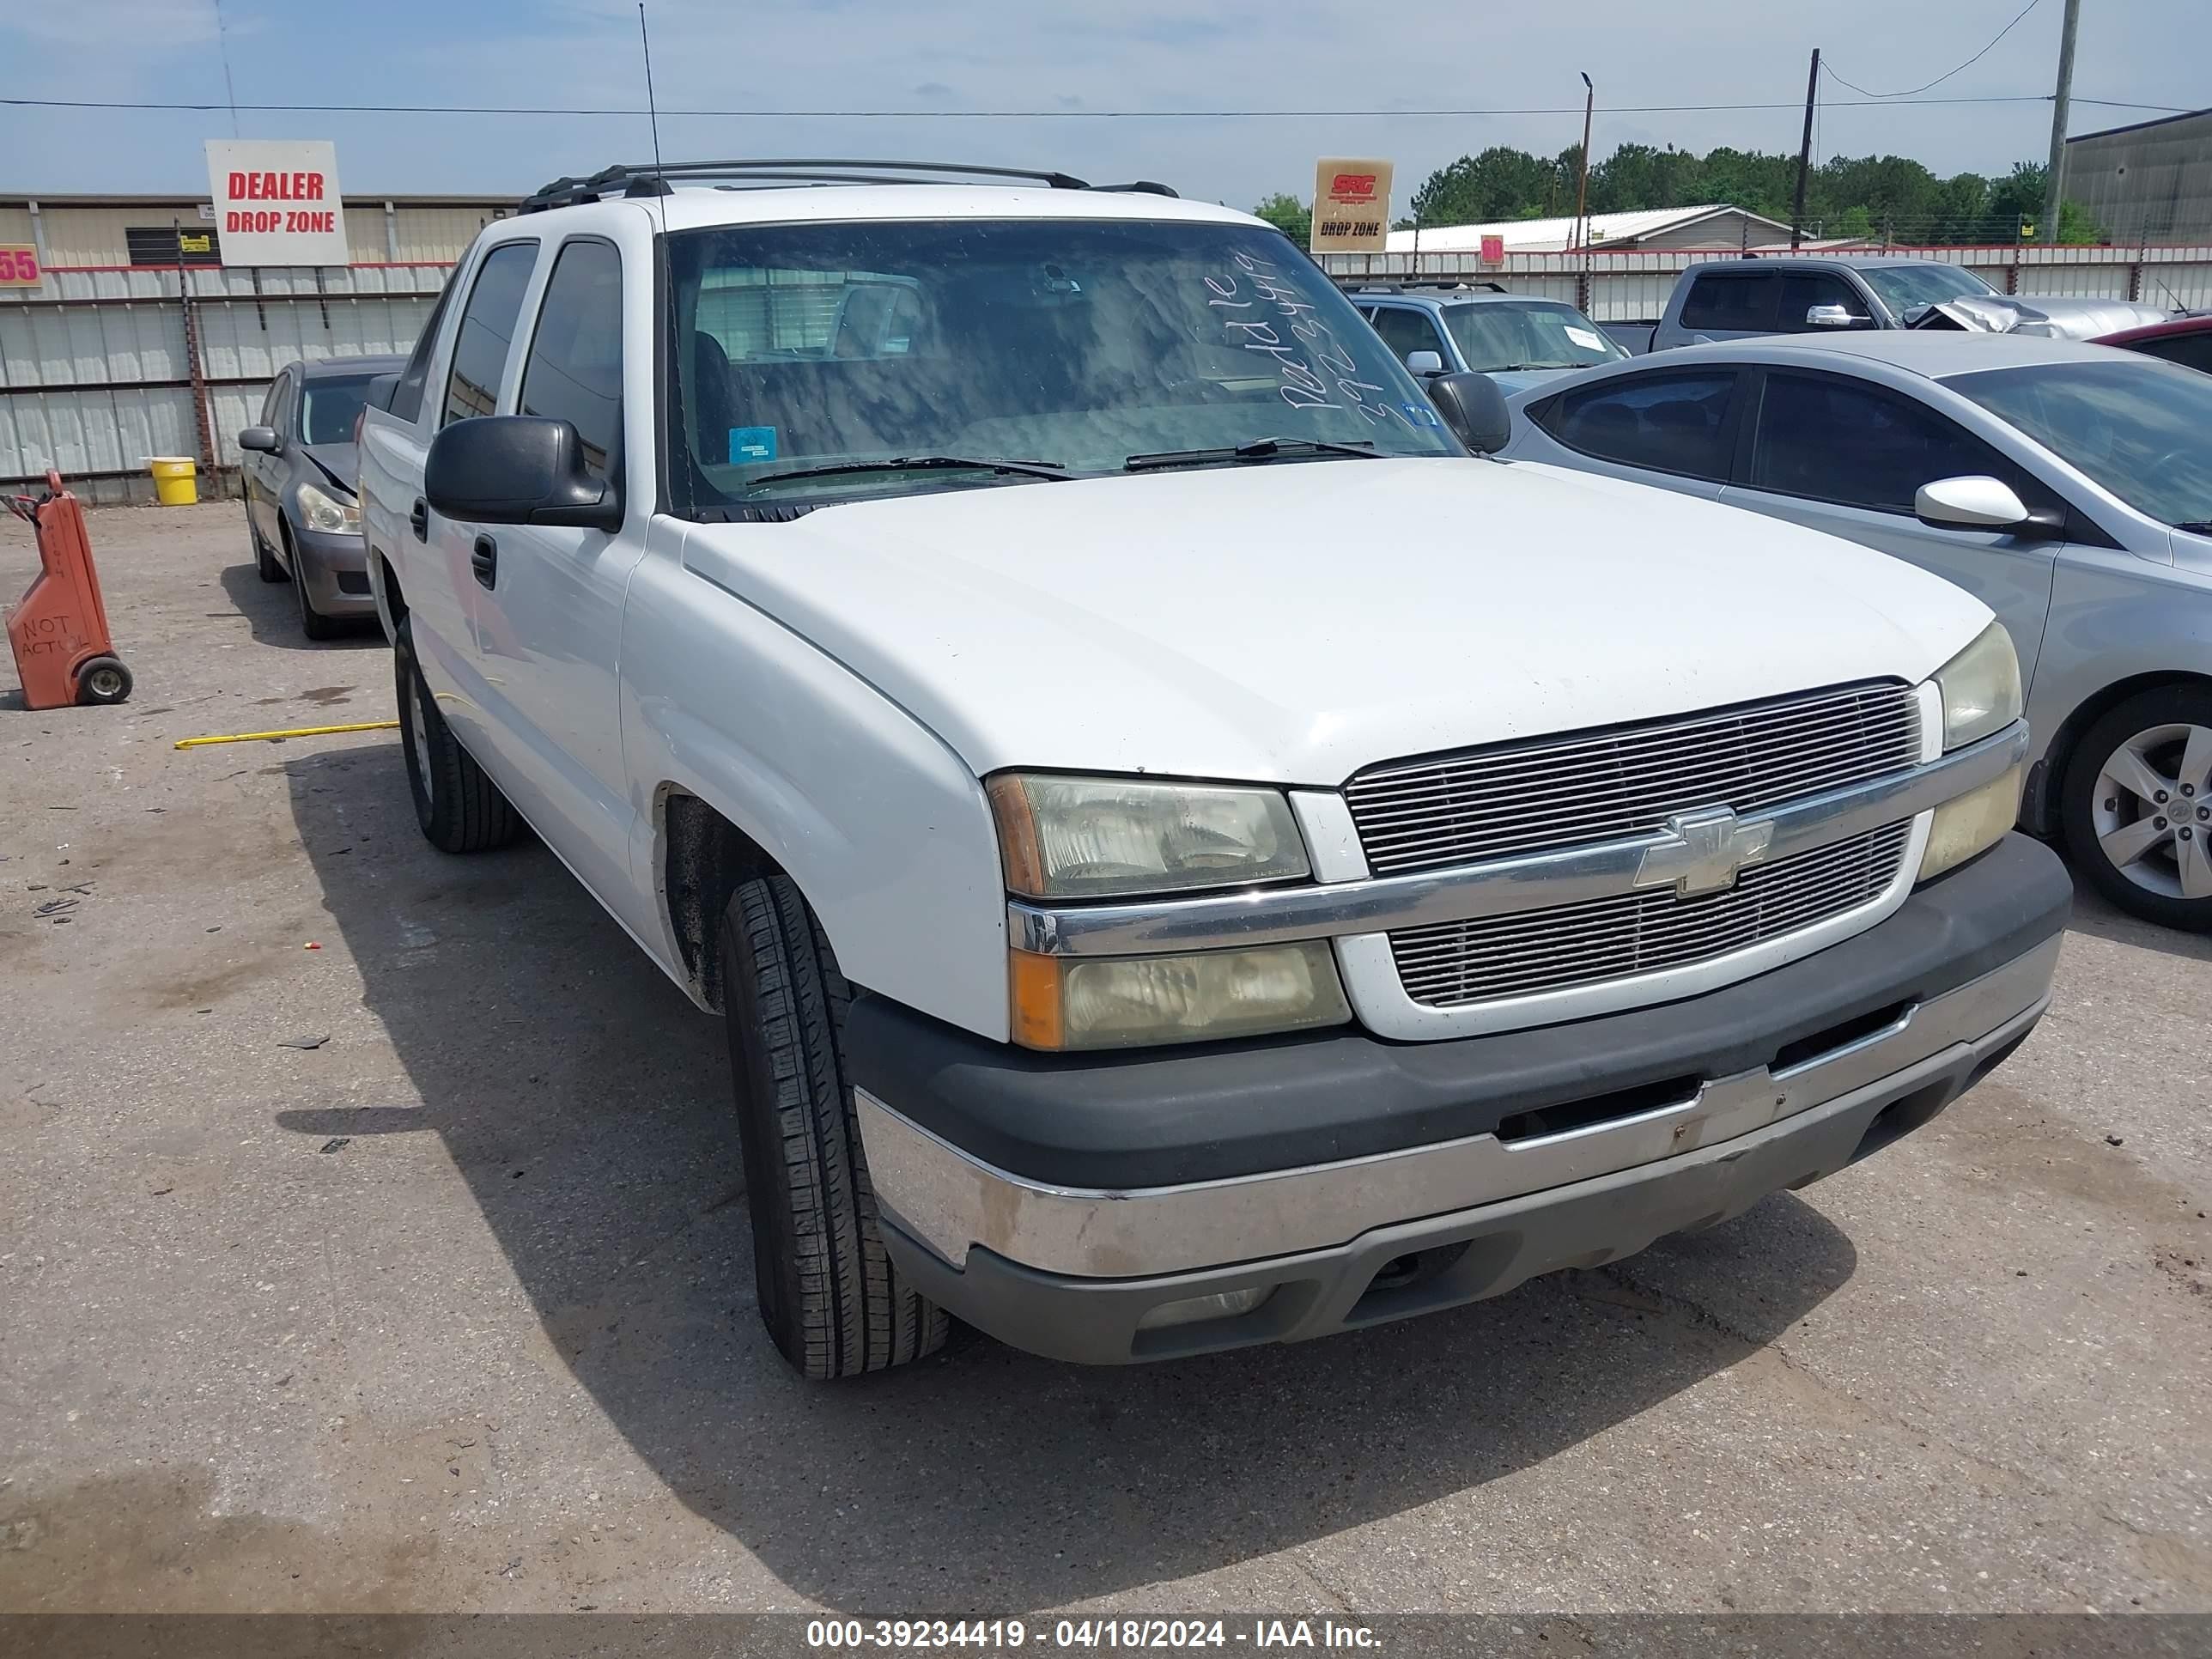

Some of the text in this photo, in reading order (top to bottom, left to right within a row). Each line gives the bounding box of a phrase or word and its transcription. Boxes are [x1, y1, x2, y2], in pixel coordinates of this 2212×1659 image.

[228, 172, 324, 200] DEALER
[1332, 174, 1376, 194] SRG
[226, 211, 282, 233] DROP
[285, 211, 335, 233] ZONE
[1320, 222, 1380, 236] DROP ZONE
[1235, 251, 1417, 433] 39234419
[22, 615, 70, 640] NOT
